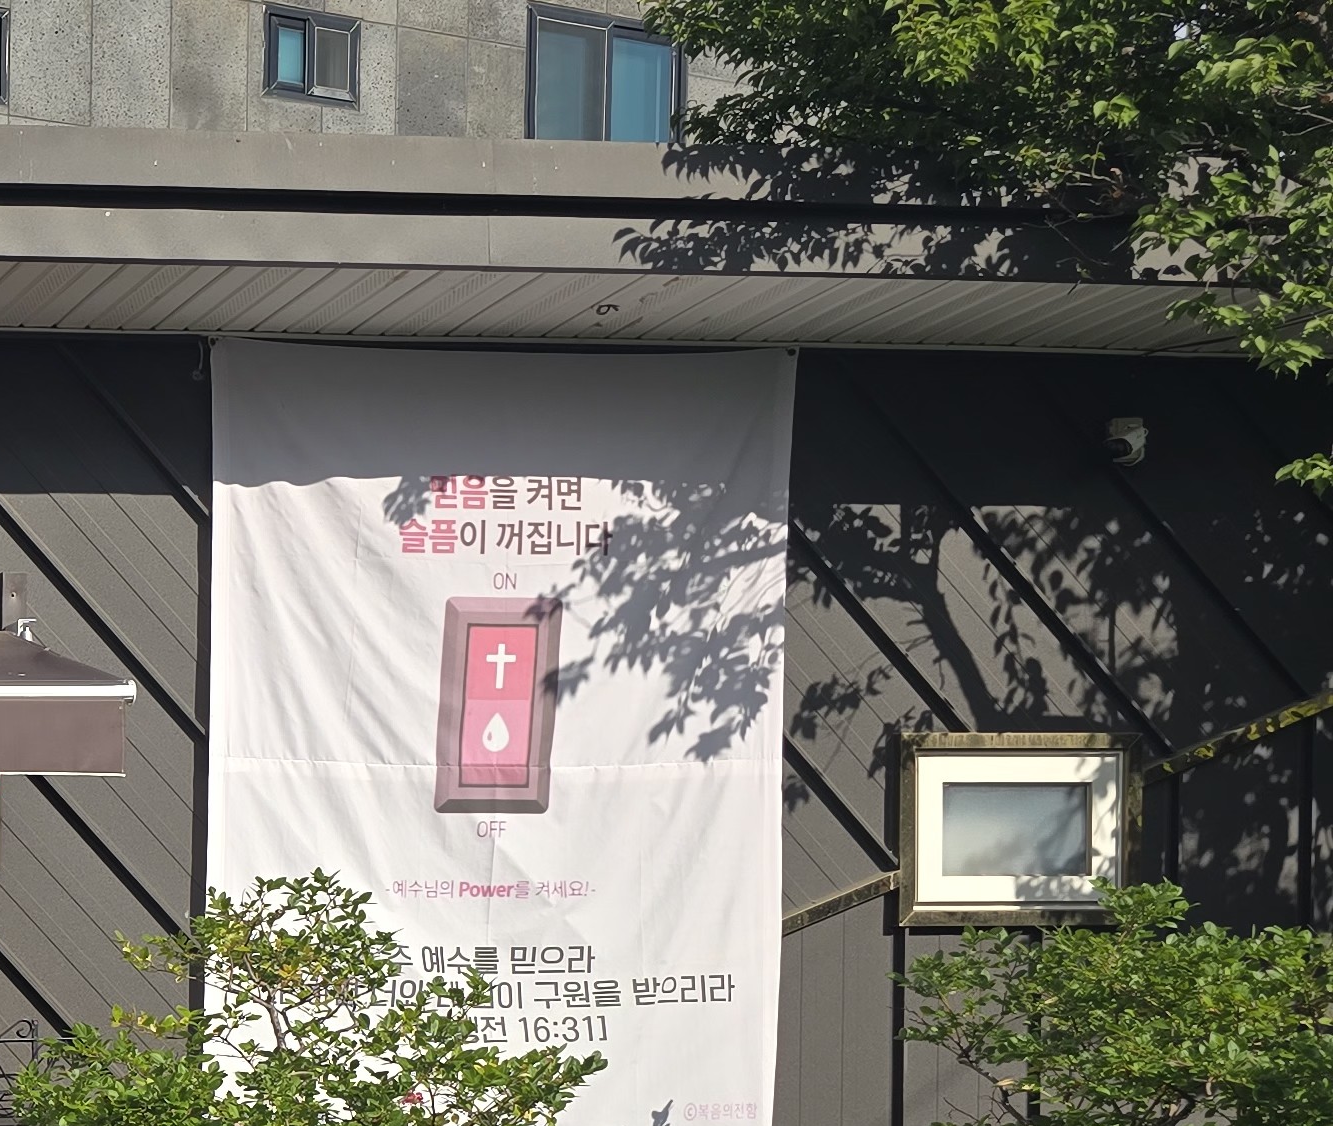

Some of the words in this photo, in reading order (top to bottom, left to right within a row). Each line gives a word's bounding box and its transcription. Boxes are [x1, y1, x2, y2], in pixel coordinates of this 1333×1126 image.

[429, 474, 518, 510] 믿음을
[526, 476, 582, 511] 켜면
[399, 518, 486, 555] 슬픔이
[496, 519, 613, 556] 꺼집니다
[493, 572, 518, 590] ON
[476, 820, 507, 838] OFF
[459, 881, 531, 898] Power를
[421, 945, 500, 975] 예수를
[510, 945, 596, 975] 믿으라
[533, 979, 622, 1009] 구원을
[631, 974, 736, 1006] 받으리라
